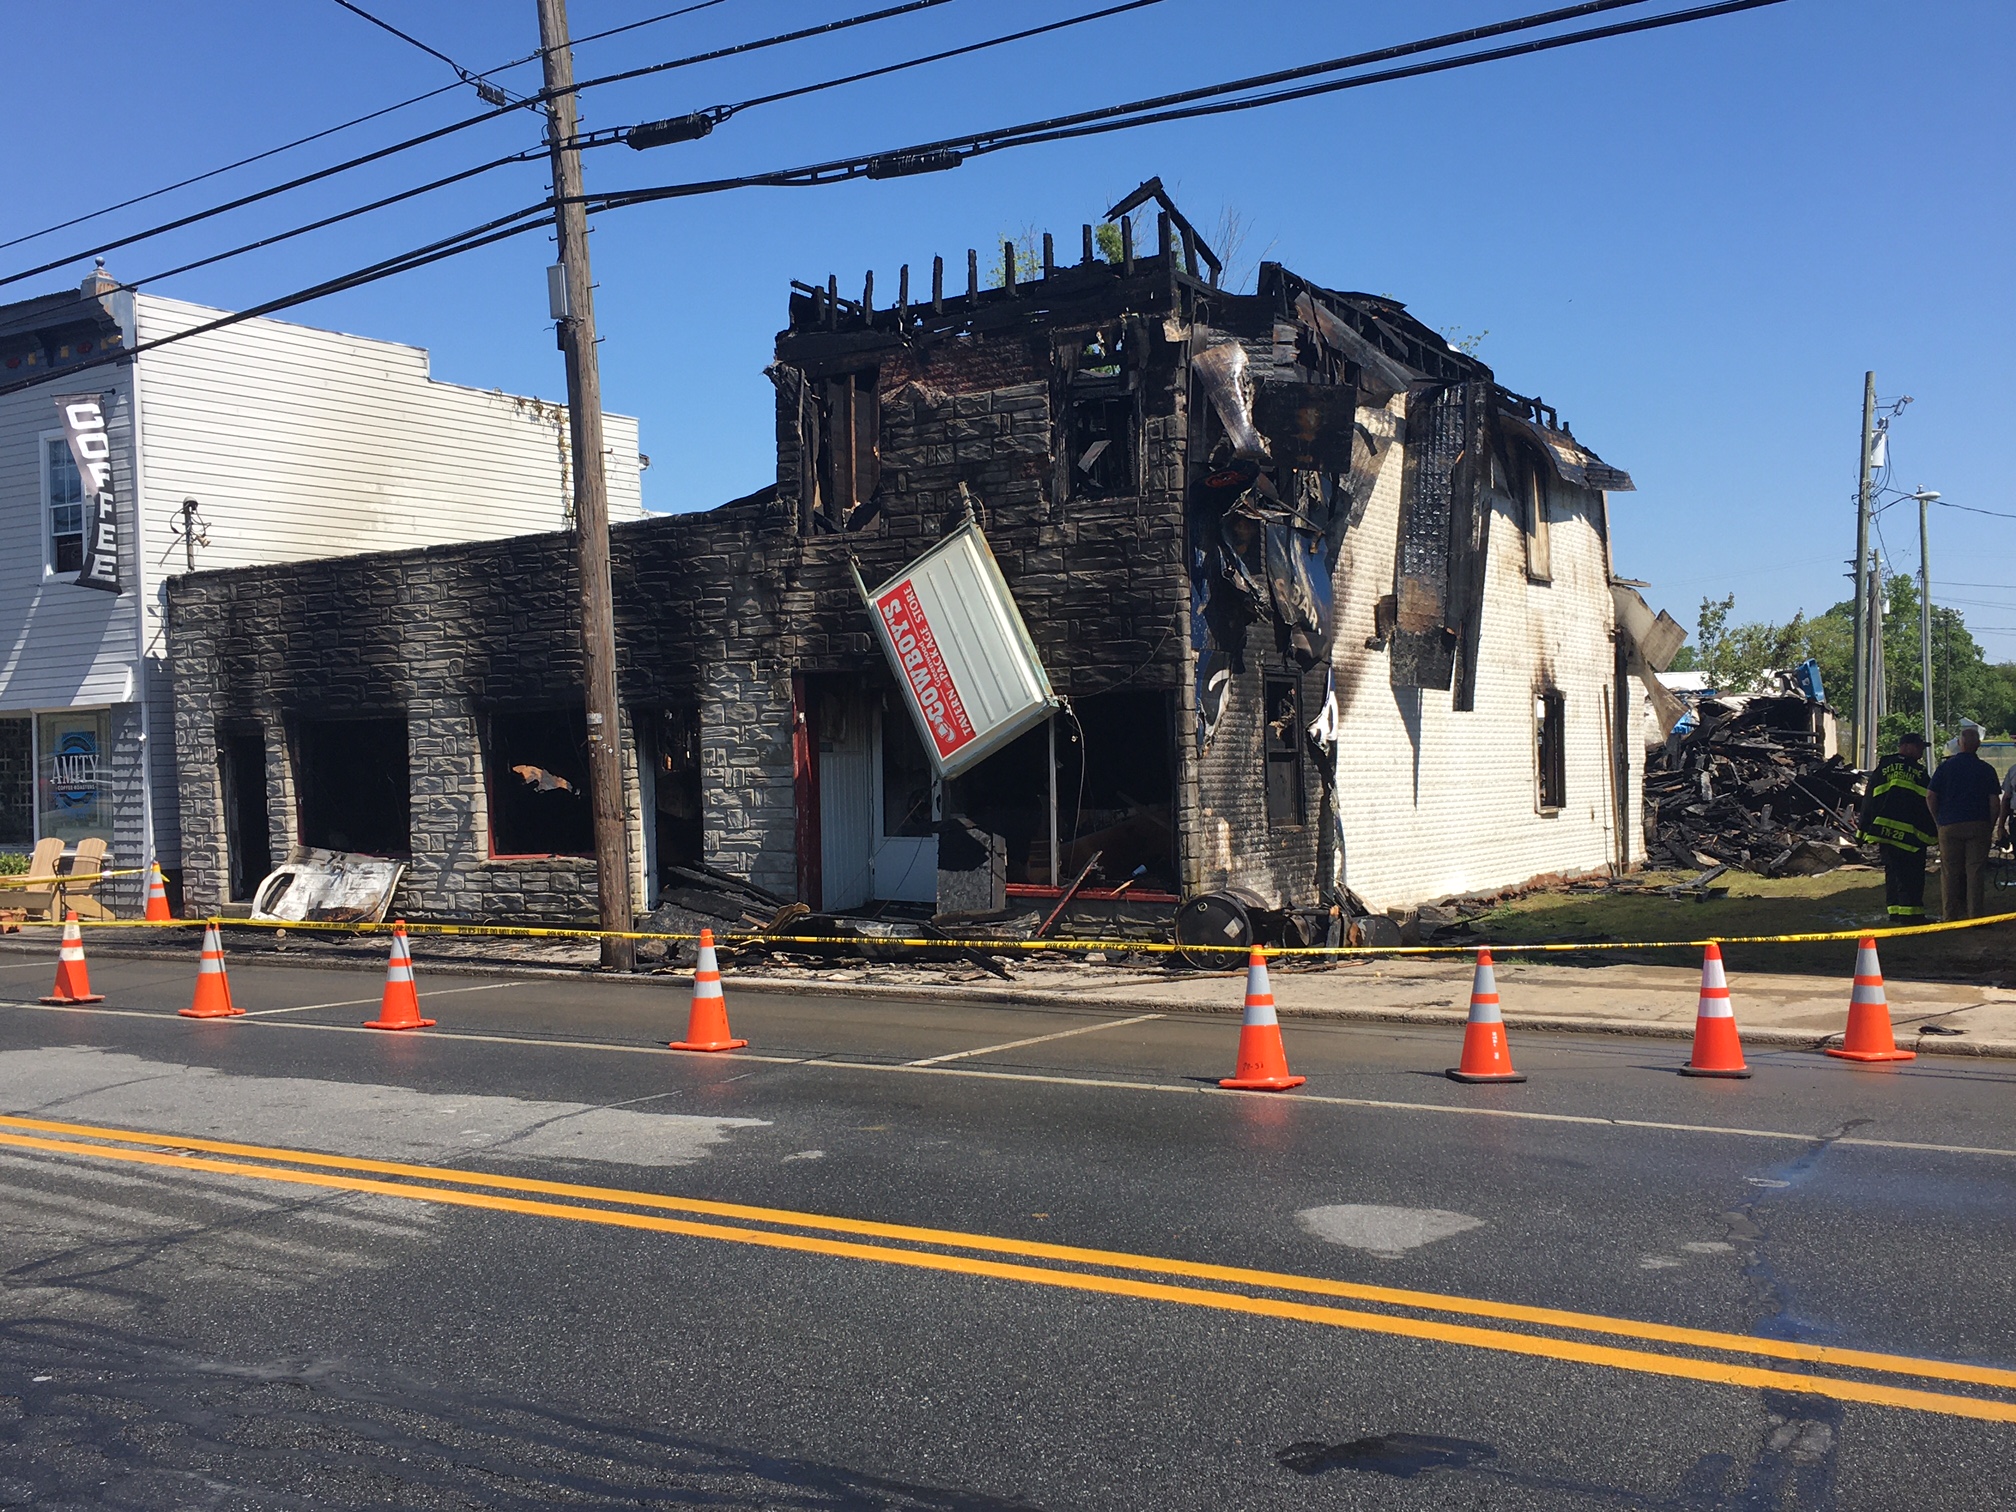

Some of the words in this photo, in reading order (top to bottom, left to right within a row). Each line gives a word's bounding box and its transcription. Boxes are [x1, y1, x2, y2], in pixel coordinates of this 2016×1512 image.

[65, 403, 117, 582] COFFEE
[903, 585, 924, 624] STORE
[883, 598, 945, 721] COWBOY'S
[917, 642, 942, 688] Greenwood
[920, 624, 951, 684] PACKAGE
[946, 690, 972, 736] TAVERN
[51, 754, 99, 785] AMITY
[1882, 762, 1904, 776] STATE
